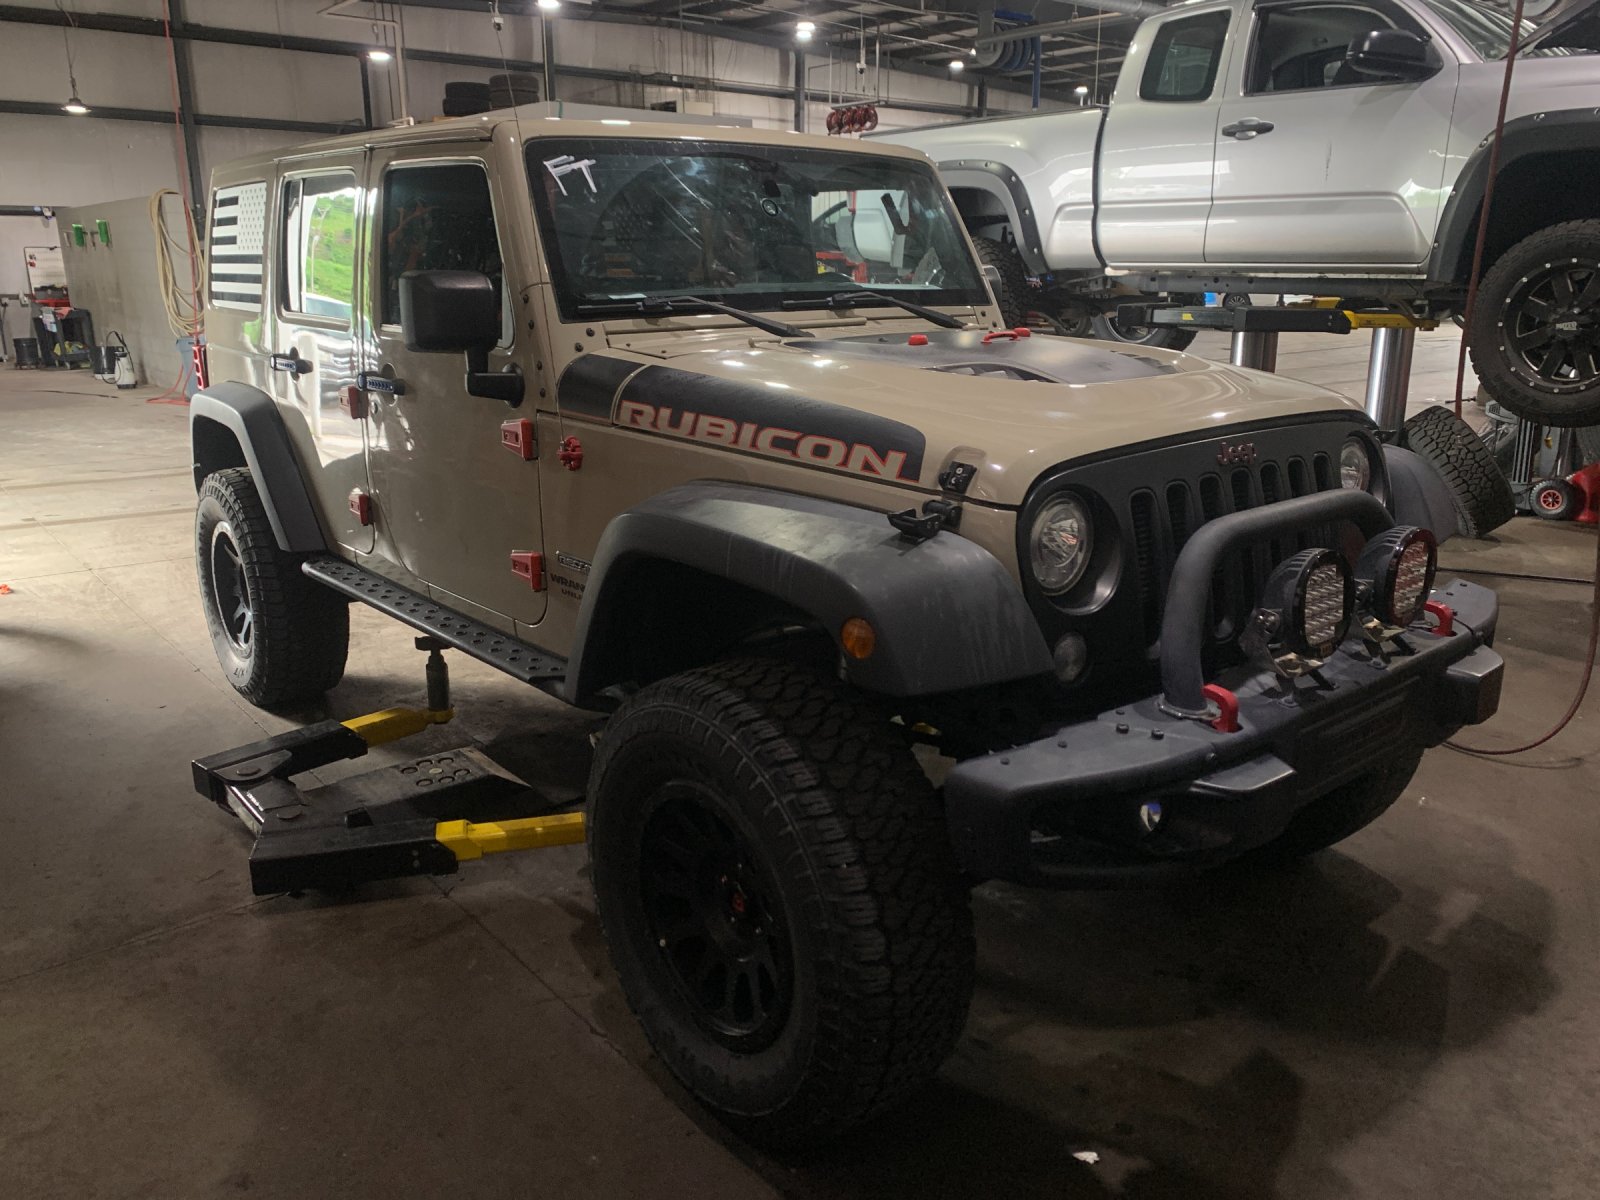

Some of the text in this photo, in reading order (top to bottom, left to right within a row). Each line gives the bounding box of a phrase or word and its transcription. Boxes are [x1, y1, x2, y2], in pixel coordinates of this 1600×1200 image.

[543, 155, 597, 196] FT
[618, 400, 908, 481] RUBICON
[1217, 441, 1257, 465] Jeep
